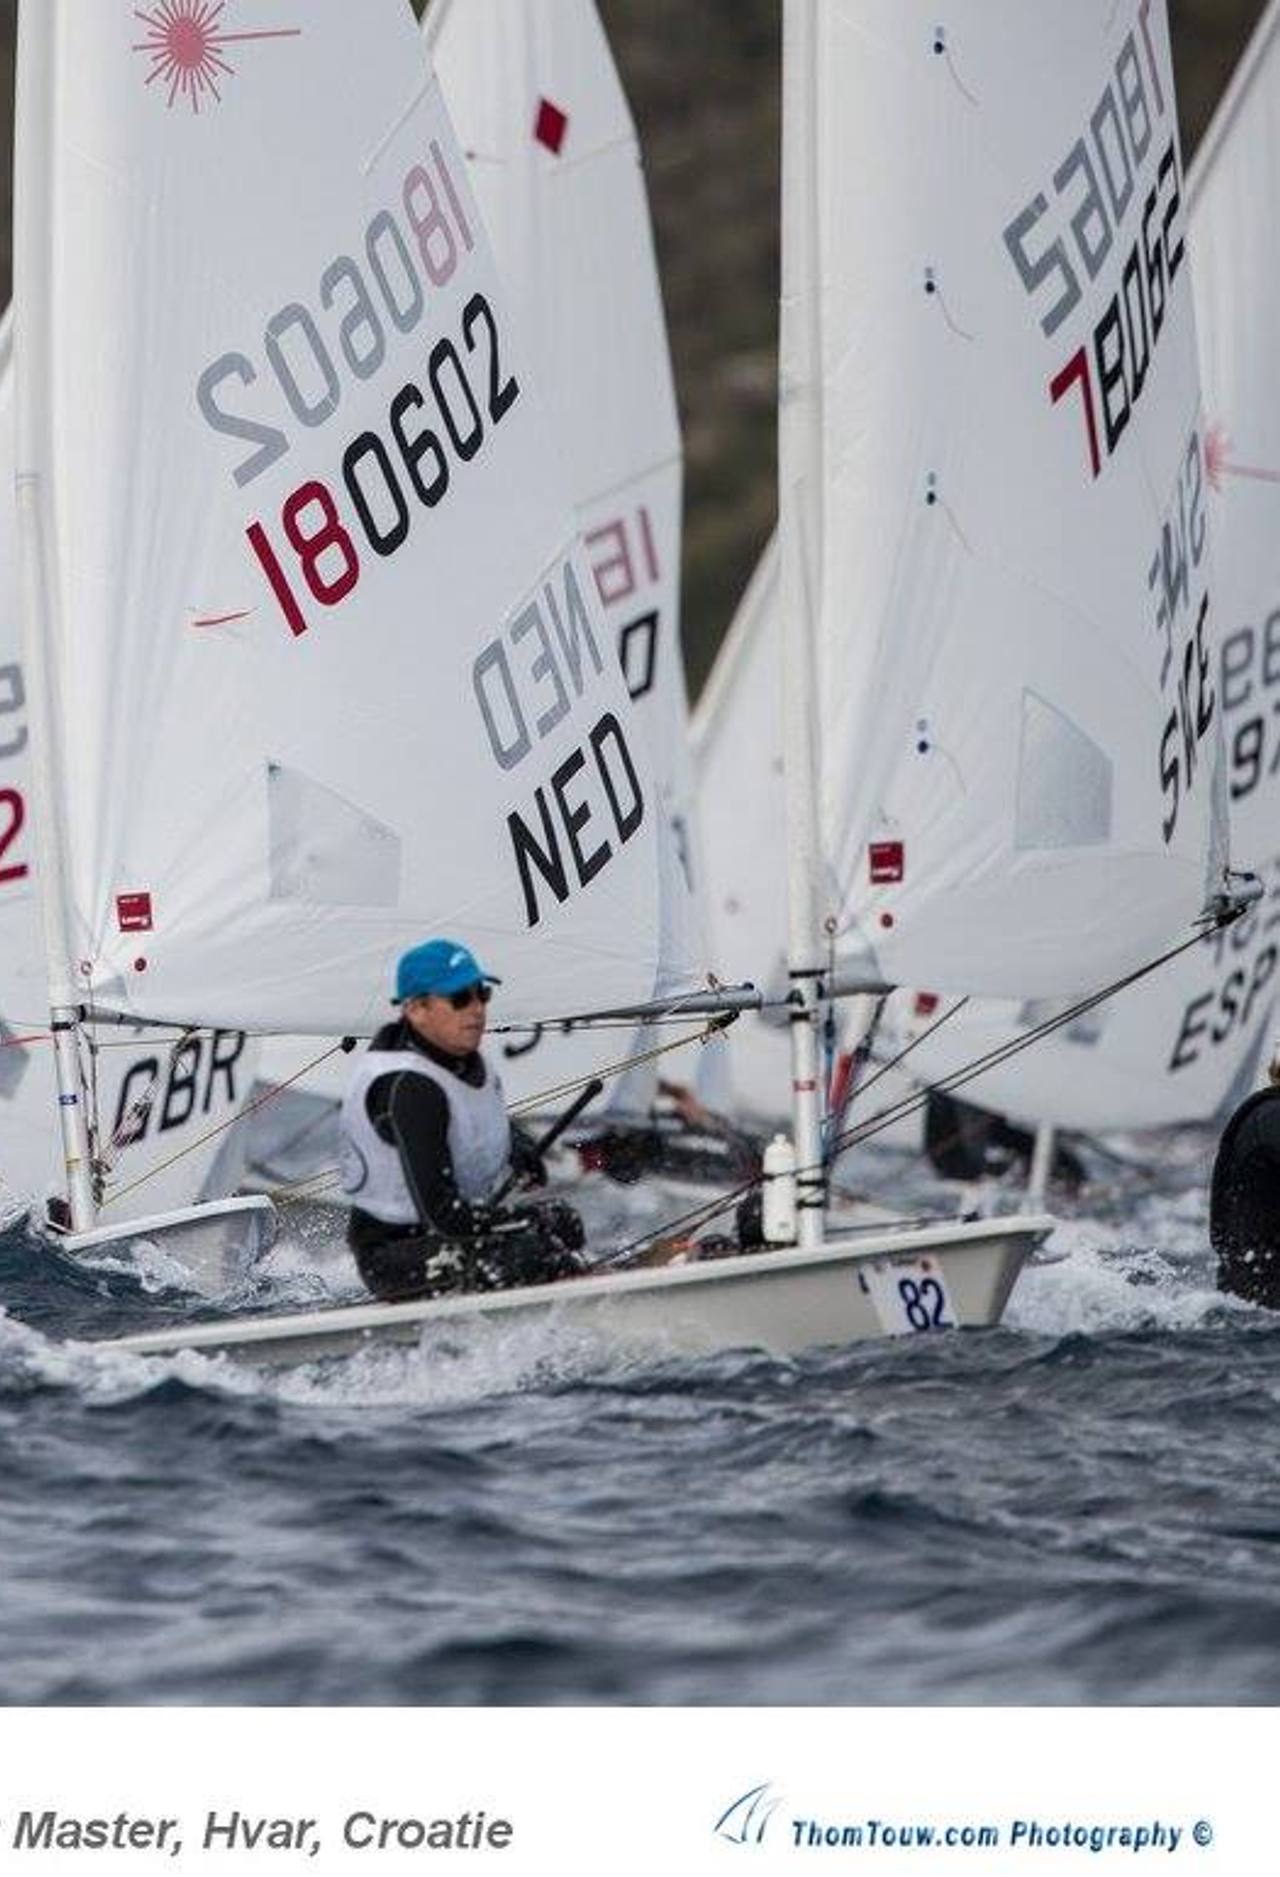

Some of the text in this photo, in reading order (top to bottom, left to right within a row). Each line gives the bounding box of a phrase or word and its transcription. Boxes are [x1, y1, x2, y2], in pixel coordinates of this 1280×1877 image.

[245, 292, 520, 636] 180602
[506, 711, 646, 927] NED
[1169, 943, 1278, 1072] ESP
[114, 1028, 246, 1147] GBR
[898, 1278, 954, 1331] 82
